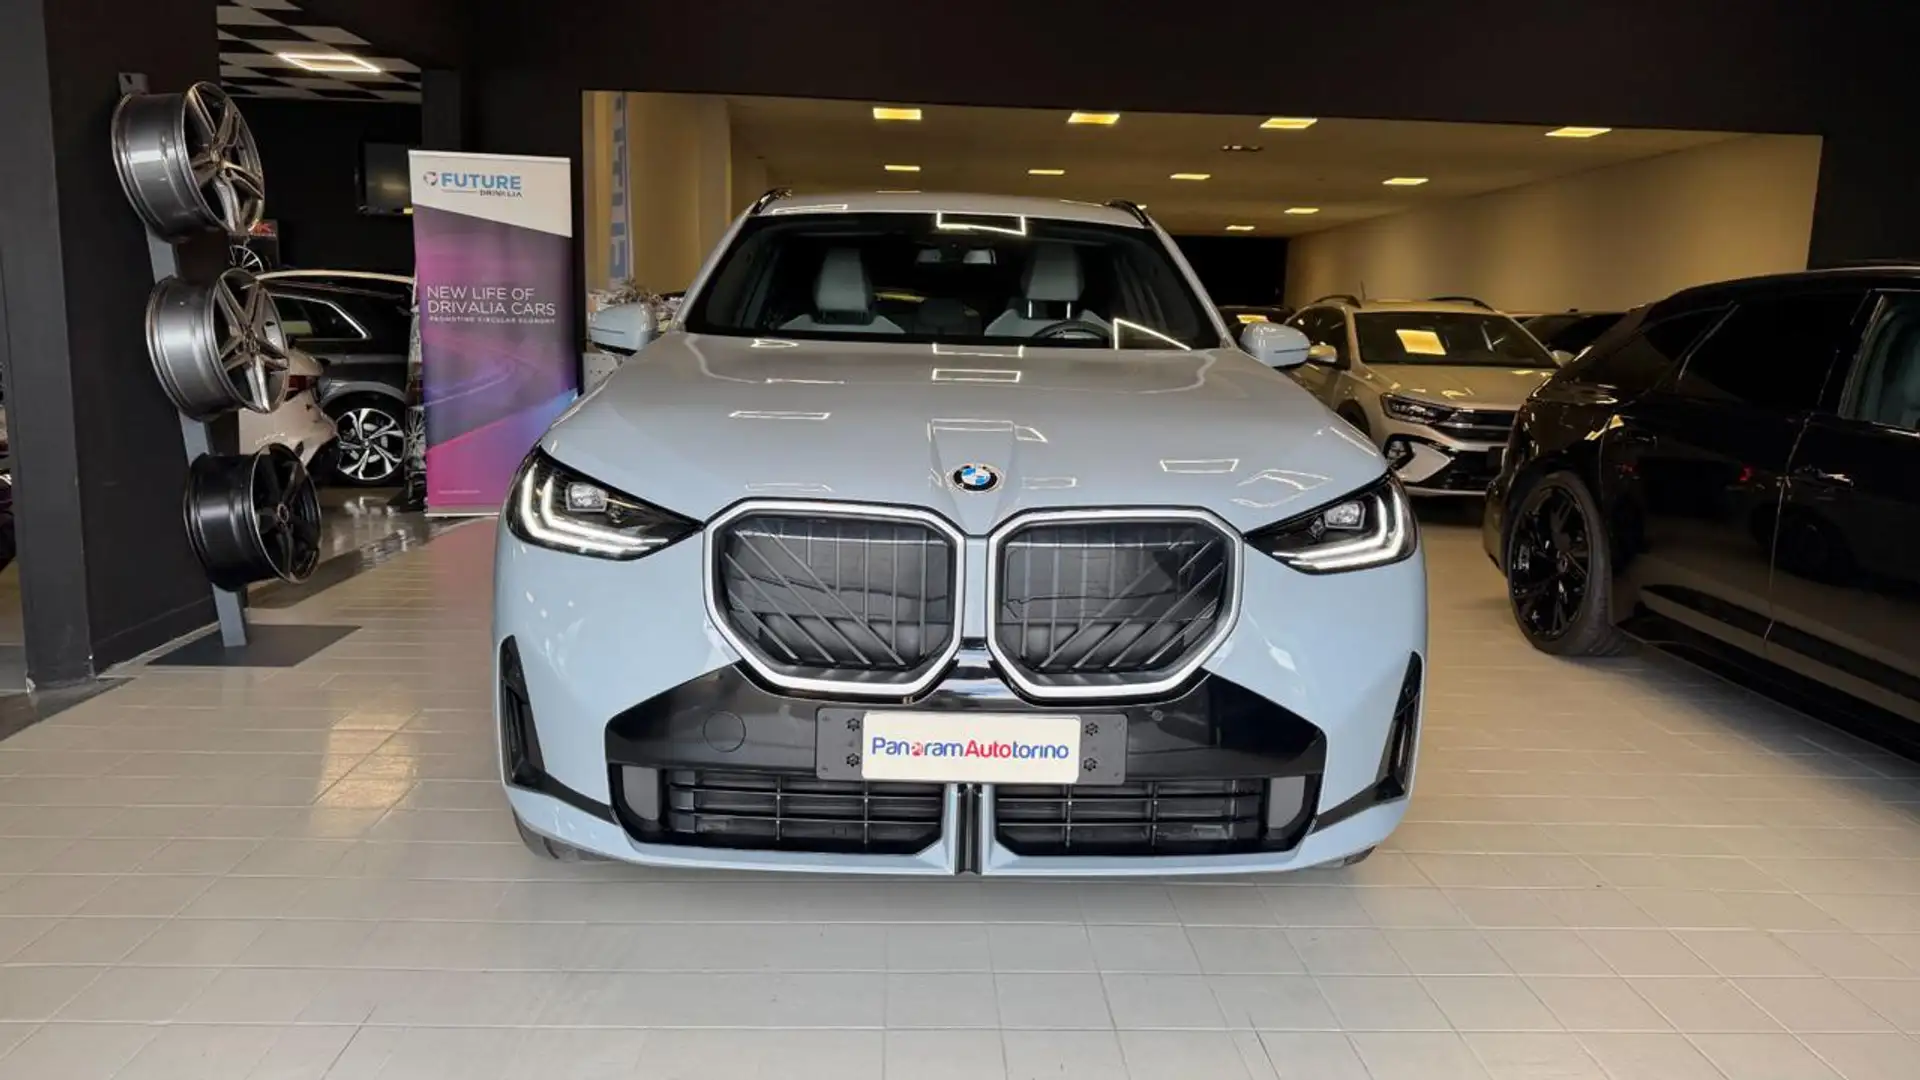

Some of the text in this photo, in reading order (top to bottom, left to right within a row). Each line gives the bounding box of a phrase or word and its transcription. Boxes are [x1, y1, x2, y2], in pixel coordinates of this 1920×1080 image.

[441, 173, 522, 190] FUTURE
[427, 286, 535, 300] NEW LIFE OF
[427, 301, 556, 316] DRIVALIA CARS
